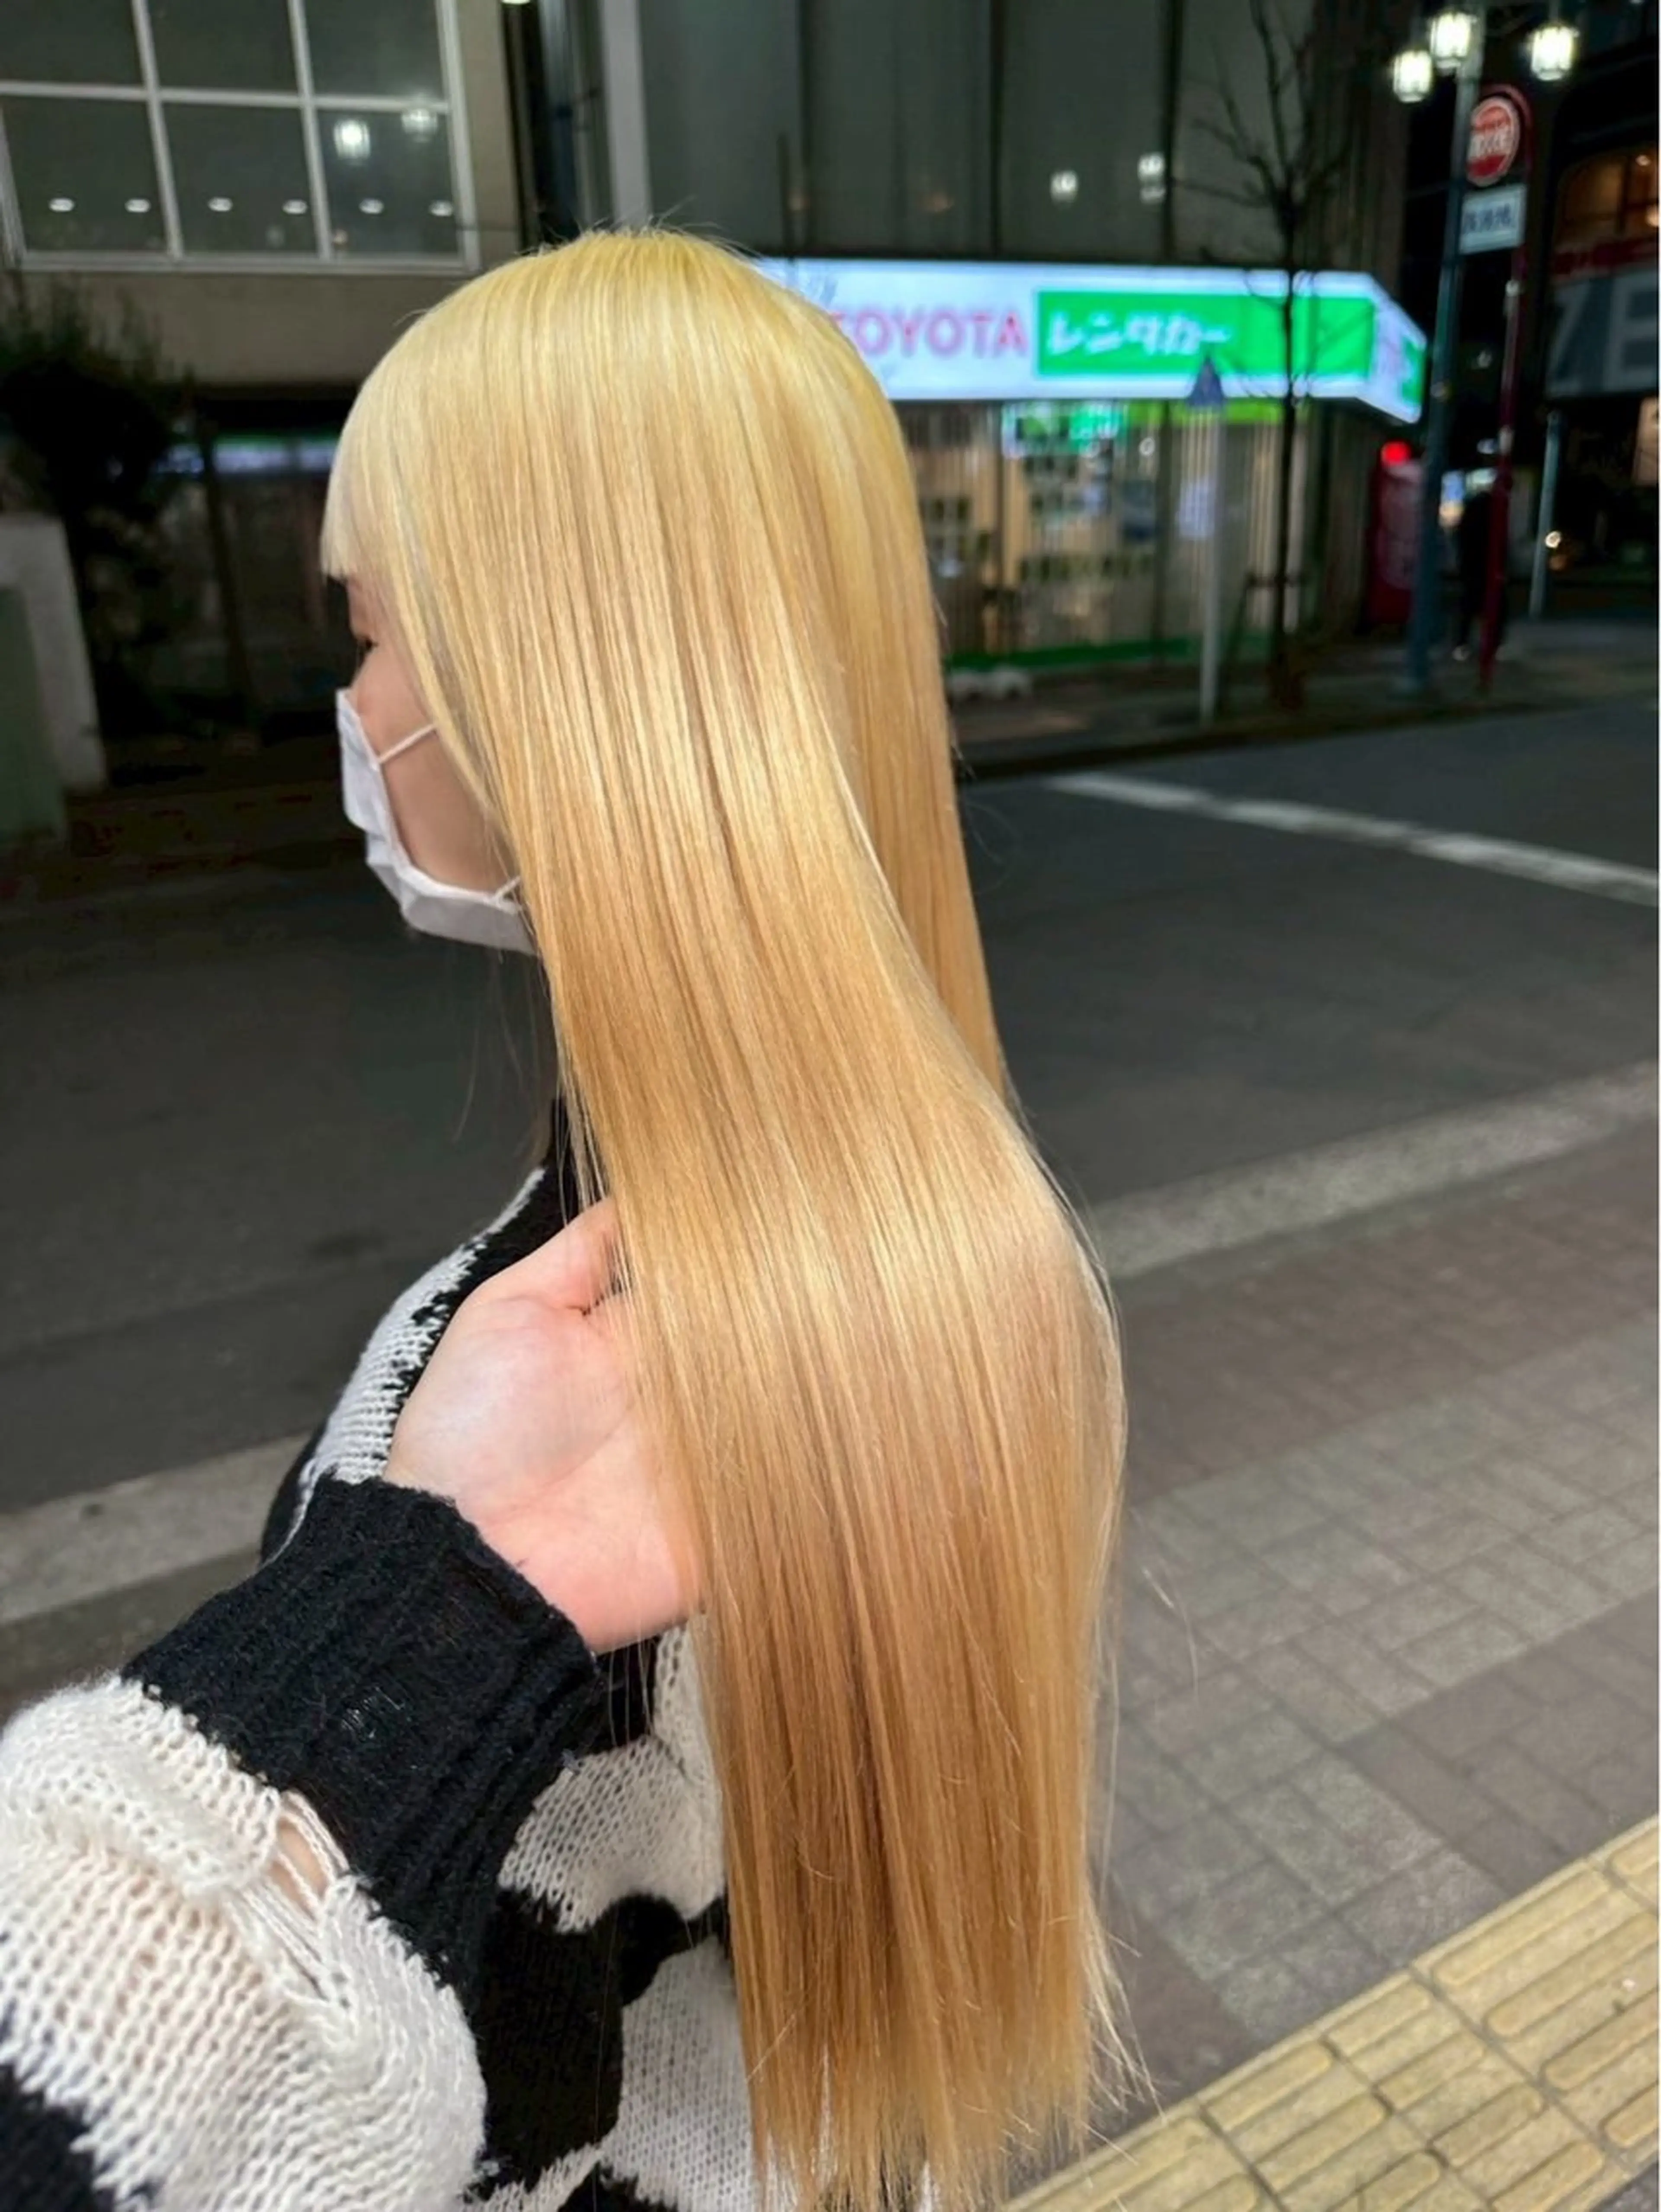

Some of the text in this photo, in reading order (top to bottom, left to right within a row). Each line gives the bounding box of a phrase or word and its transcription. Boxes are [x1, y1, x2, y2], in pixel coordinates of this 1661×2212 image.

[1048, 312, 1232, 356] レンタカー
